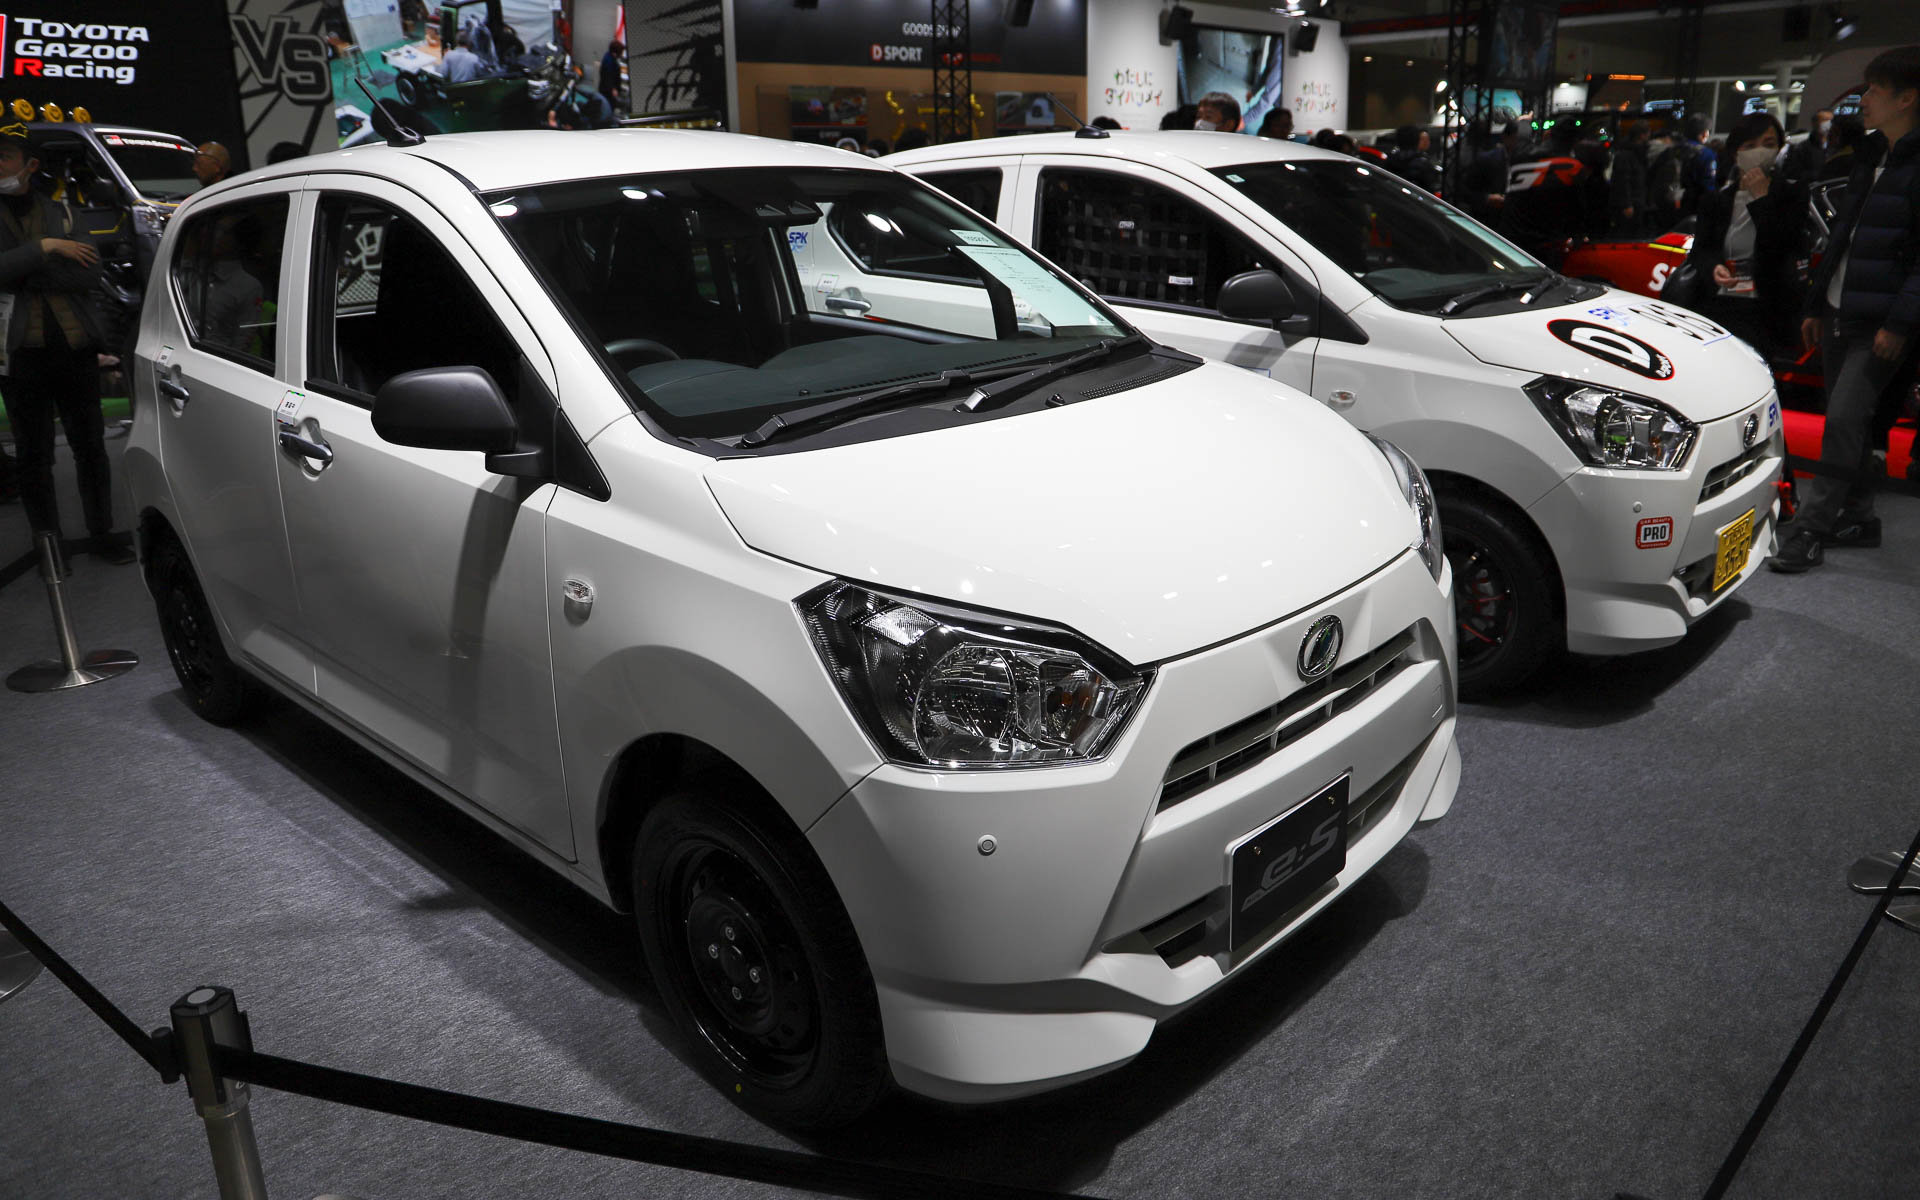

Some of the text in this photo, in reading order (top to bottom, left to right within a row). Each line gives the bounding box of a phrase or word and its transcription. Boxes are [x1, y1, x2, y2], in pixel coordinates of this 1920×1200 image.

[14, 17, 149, 42] TOYOTA
[14, 38, 138, 61] GAZOO
[229, 13, 330, 100] VS
[884, 45, 923, 62] SPORT
[14, 57, 136, 85] Racing
[1506, 156, 1584, 193] GR
[789, 231, 809, 245] SPK
[1643, 525, 1667, 541] PRO
